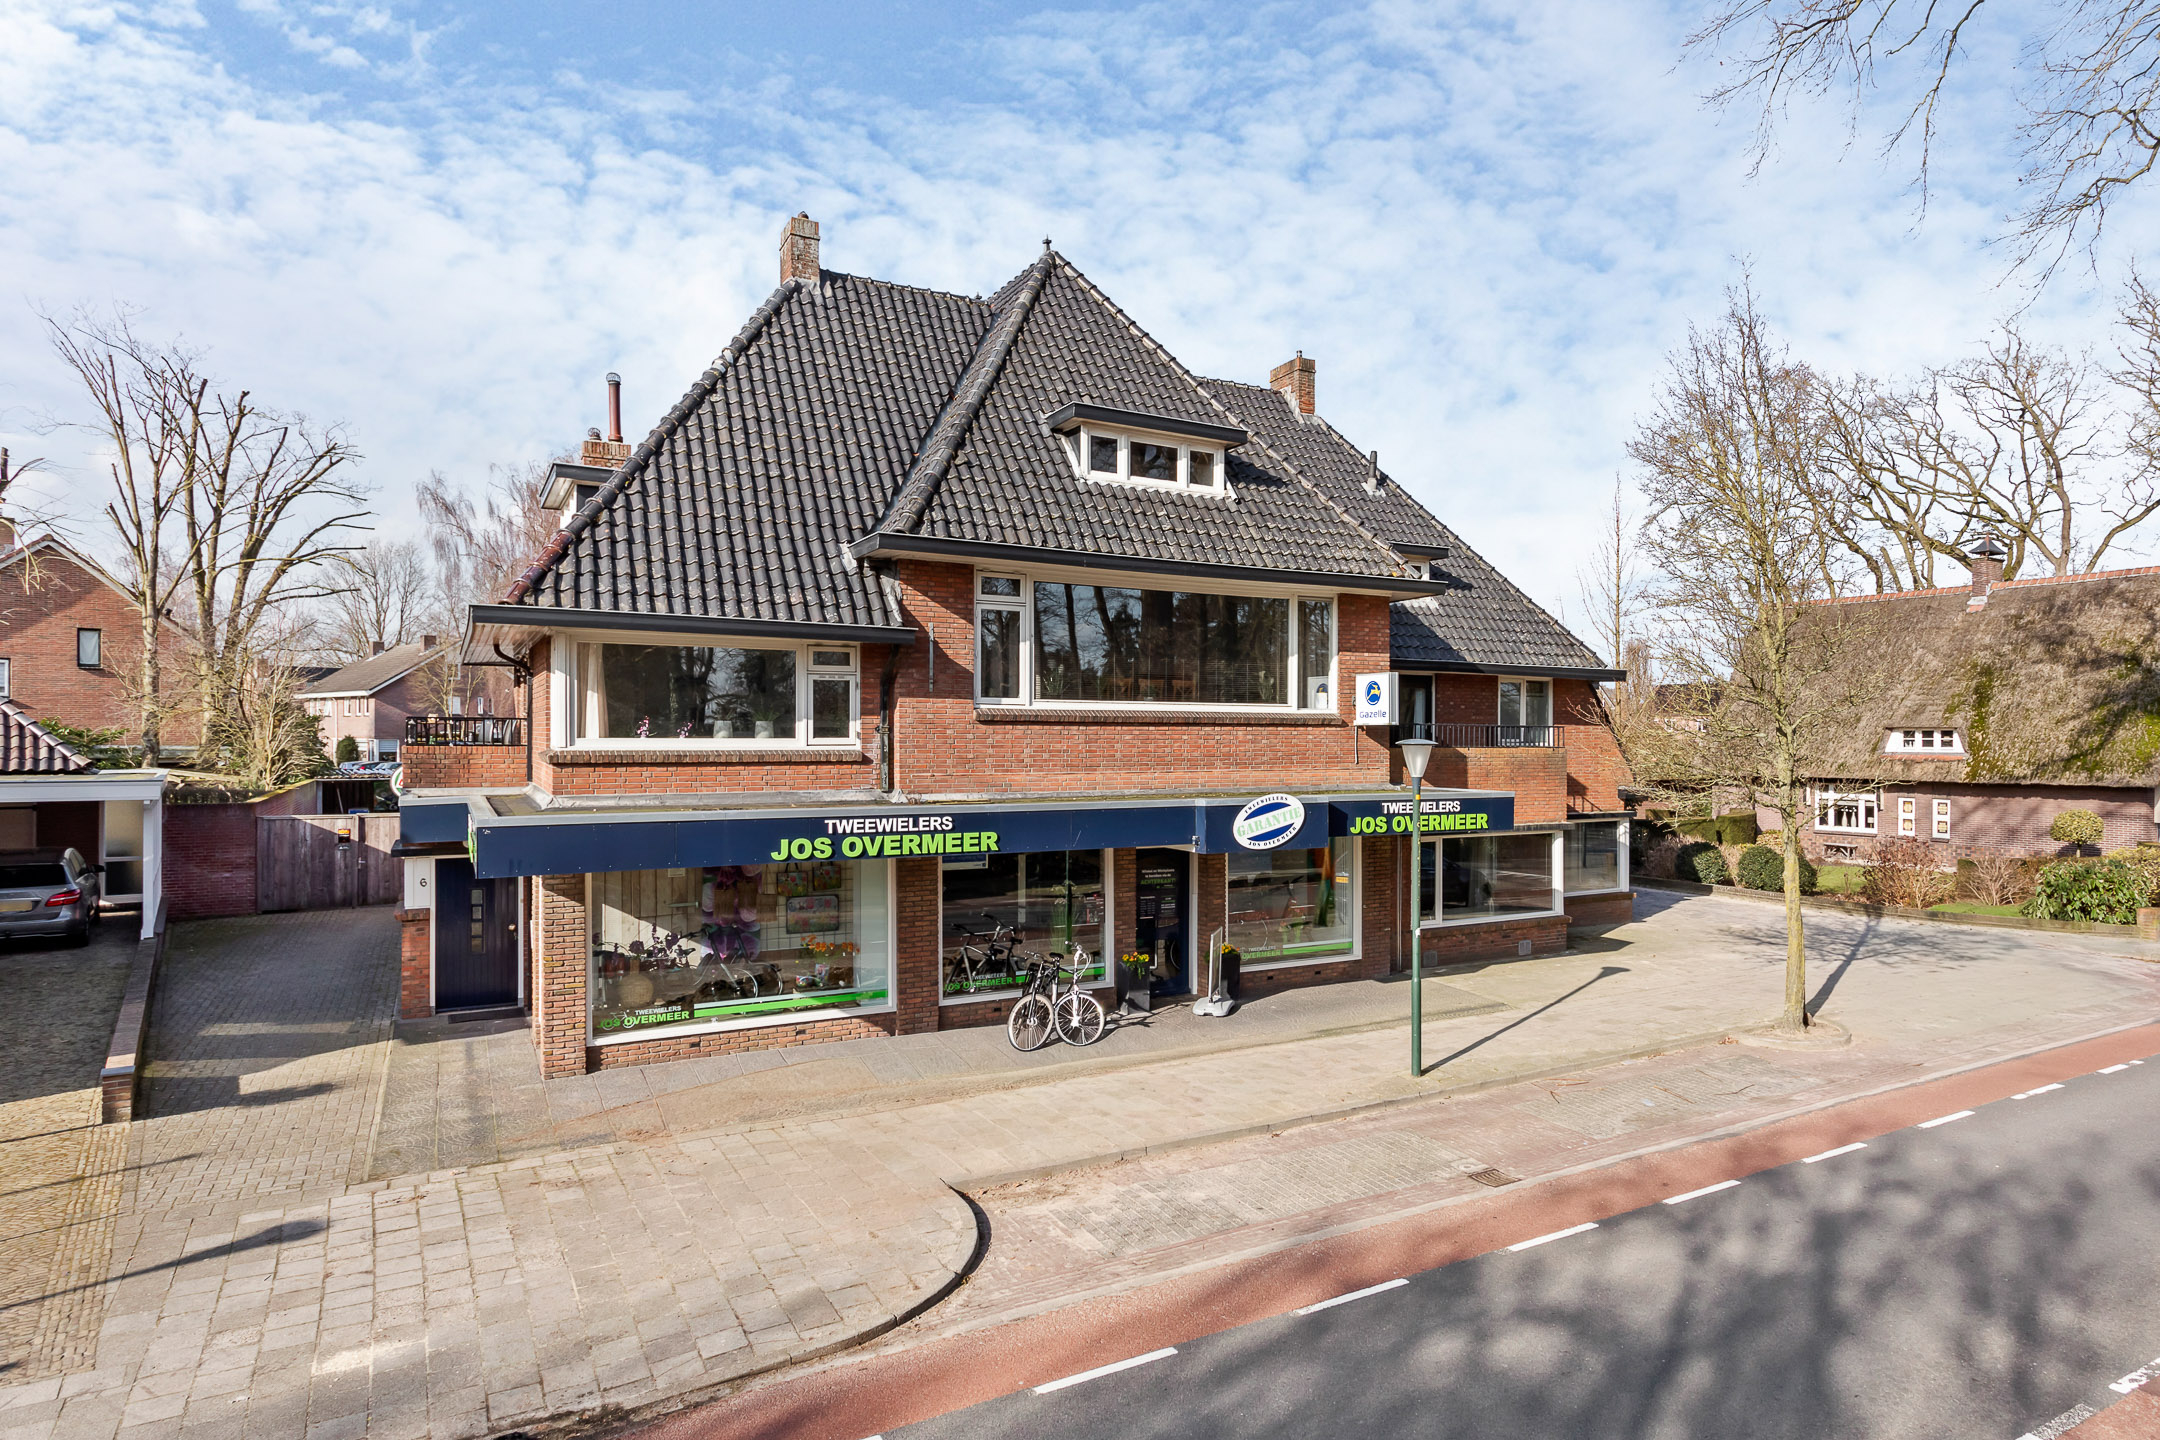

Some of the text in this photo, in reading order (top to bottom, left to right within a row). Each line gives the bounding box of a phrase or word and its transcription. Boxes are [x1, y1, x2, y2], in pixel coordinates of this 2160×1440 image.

[1359, 709, 1387, 719] Gazelle
[824, 816, 953, 834] TWEEWIELERS
[1237, 807, 1301, 837] GARANTIE
[1349, 813, 1489, 835] JOS OVERMEER
[770, 831, 999, 861] JOS OVERMEER
[420, 878, 428, 887] 6
[597, 1011, 690, 1029] JOS OVERMEER
[635, 1006, 682, 1016] TWEEWIELERS
